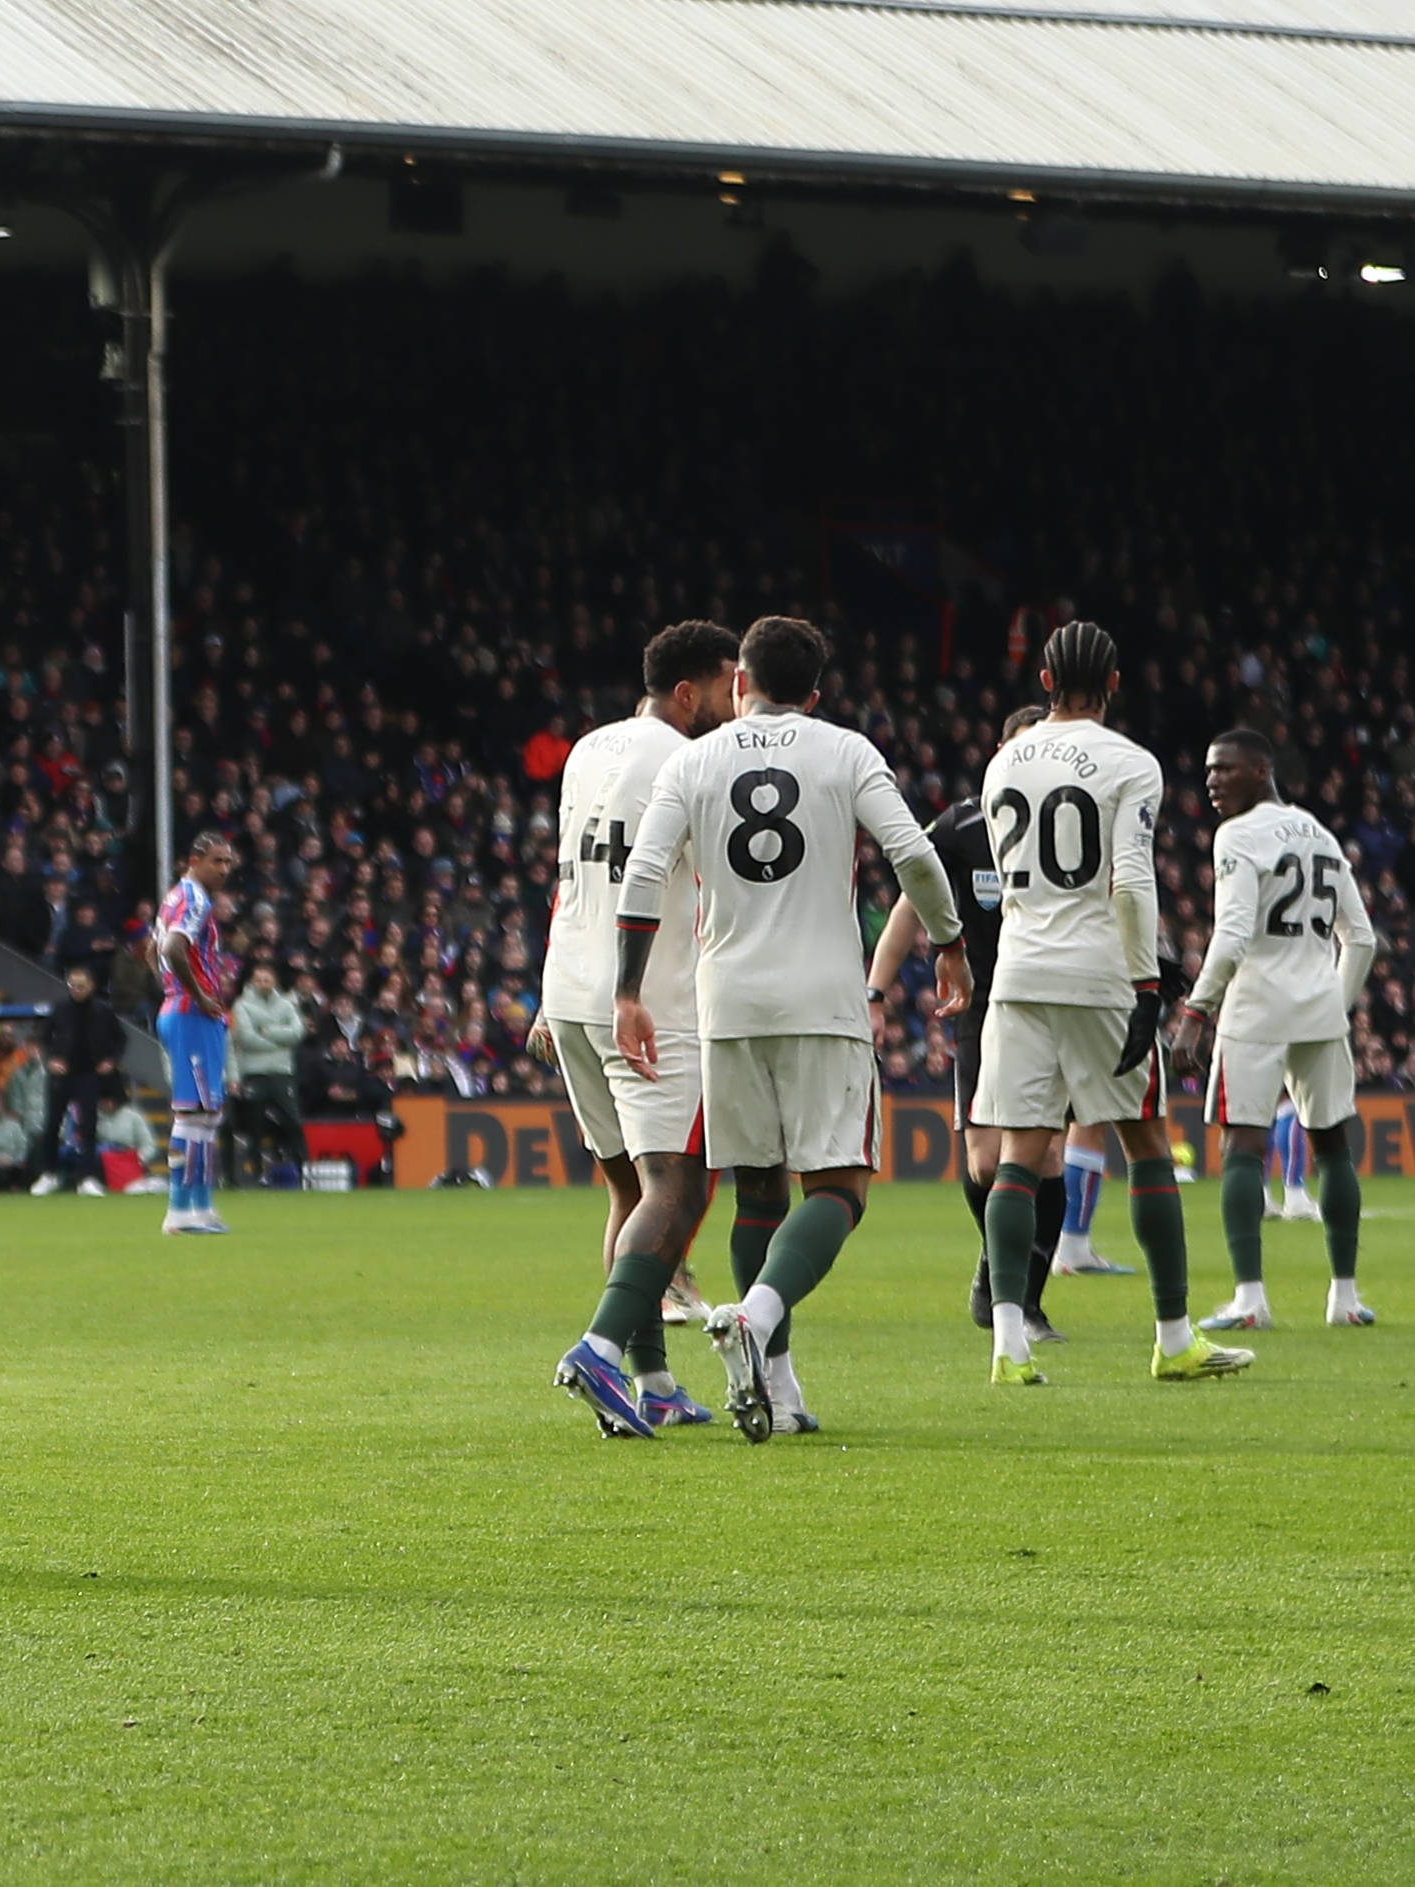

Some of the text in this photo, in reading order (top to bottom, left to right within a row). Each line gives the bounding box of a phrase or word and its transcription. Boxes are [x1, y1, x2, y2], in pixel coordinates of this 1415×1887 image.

[736, 729, 797, 750] ENZO
[1040, 742, 1098, 780] PEDRO
[727, 767, 806, 883] 8
[990, 784, 1102, 890] 20
[975, 873, 1000, 883] FIFA
[1266, 852, 1341, 940] 25
